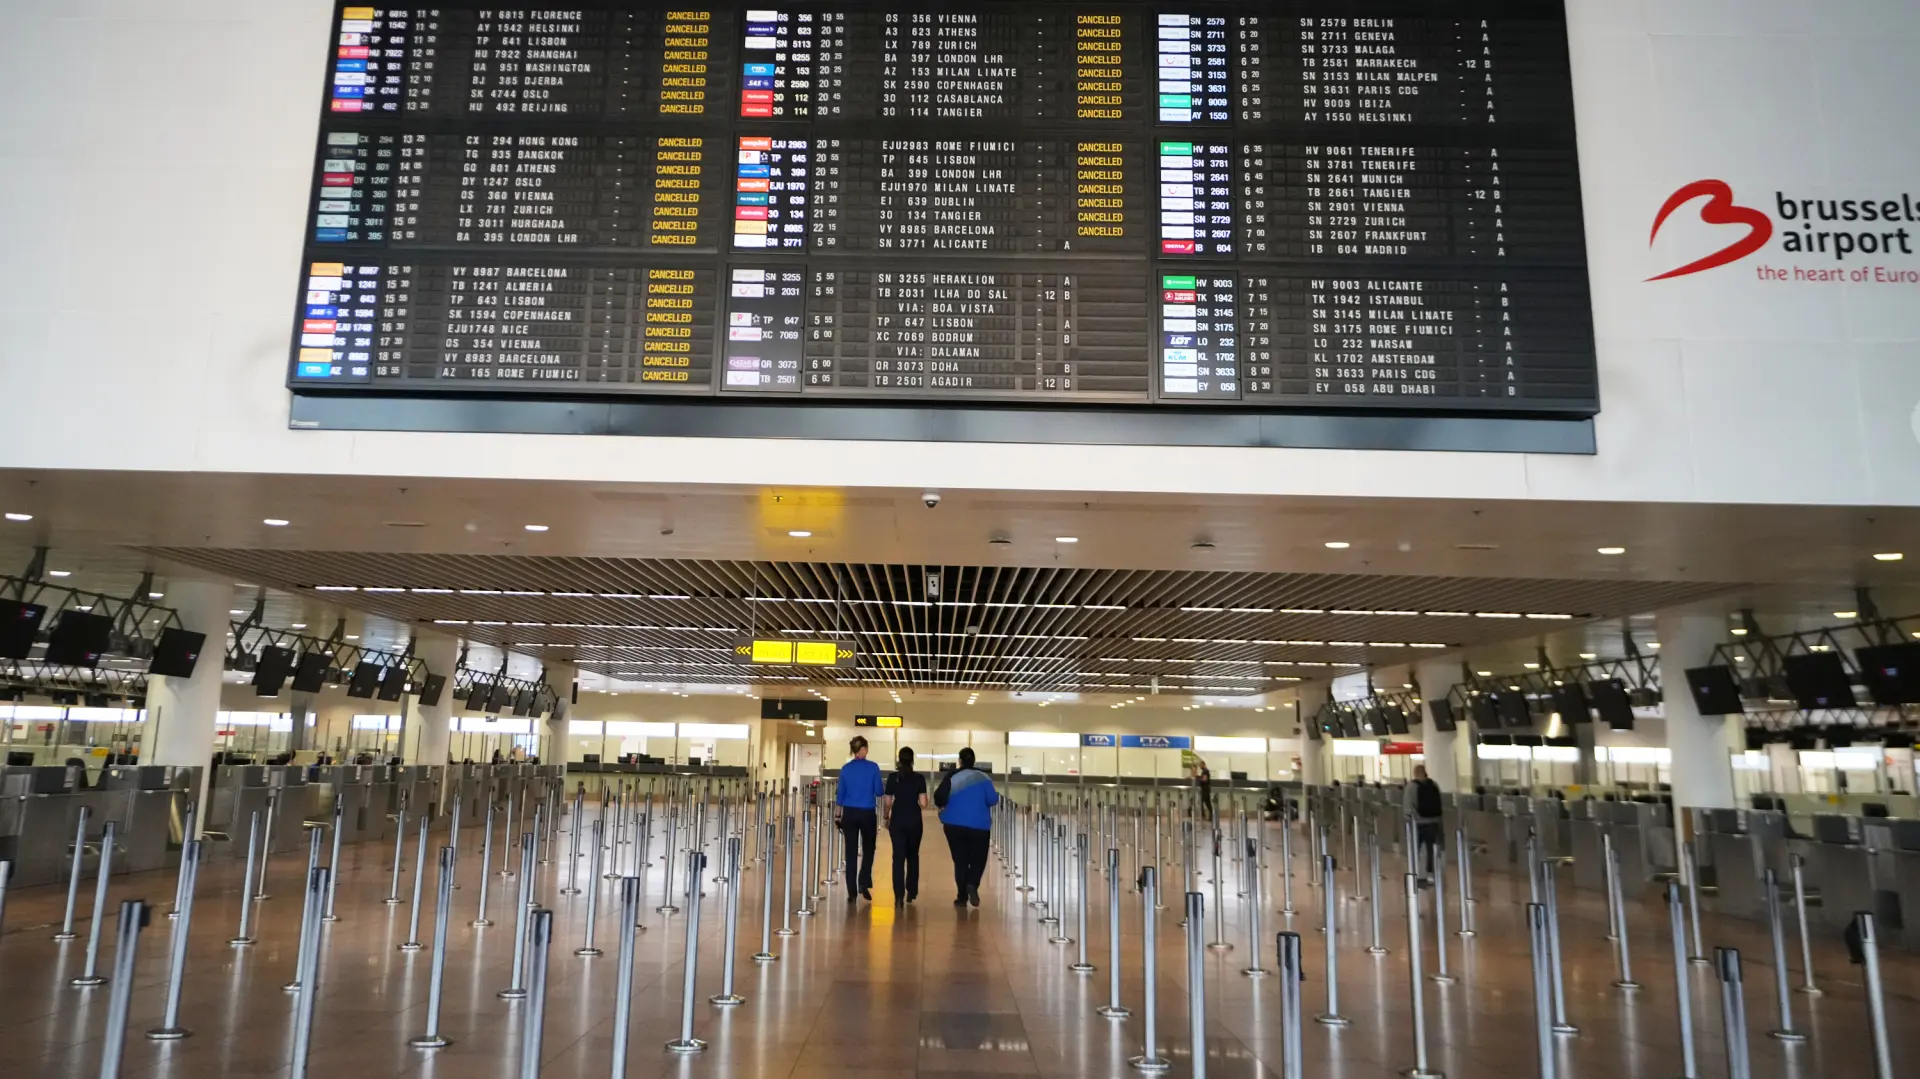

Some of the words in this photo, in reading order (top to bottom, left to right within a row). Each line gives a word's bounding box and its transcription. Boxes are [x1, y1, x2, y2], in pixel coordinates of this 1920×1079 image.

[479, 10, 492, 19] VY
[498, 10, 524, 19] 6815
[530, 10, 582, 20] FLORENCE
[666, 11, 710, 20] CANCELLED
[885, 13, 898, 23] OS
[912, 14, 930, 23] 356
[938, 14, 977, 23] VIENNA
[1077, 15, 1121, 24] CANCELLED
[1190, 17, 1201, 25] SN
[1206, 17, 1225, 26] 2579
[1239, 17, 1245, 26] 6
[1300, 17, 1313, 27] SN
[1320, 18, 1346, 27] 2579
[1353, 18, 1393, 28] BERLIN
[477, 23, 490, 31] AY
[497, 23, 522, 32] 1542
[528, 23, 579, 33] HELSINKI
[776, 26, 788, 35] A3
[797, 26, 812, 35] 623
[820, 26, 832, 35] 20
[474, 49, 488, 58] HU
[495, 49, 520, 59] 7922
[526, 49, 577, 59] SHANGHAI
[664, 50, 708, 60] CANCELLED
[884, 53, 897, 62] BA
[911, 53, 930, 62] 397
[937, 54, 976, 63] LONDON
[984, 54, 1002, 63] LHR
[1190, 57, 1201, 65] TB
[1207, 57, 1225, 66] 2581
[1302, 58, 1315, 67] TB
[1322, 58, 1348, 67] 2581
[1355, 58, 1416, 68] MARRAKECH
[884, 66, 896, 76] AZ
[911, 67, 929, 76] 153
[936, 67, 970, 76] MILAN
[977, 68, 1016, 76] LINATE
[1077, 68, 1122, 78] CANCELLED
[1303, 84, 1316, 94] SN
[1323, 85, 1349, 94] 3631
[1357, 85, 1390, 94] PARIS
[1398, 86, 1418, 95] CDG
[660, 90, 704, 100] CANCELLED
[466, 136, 479, 144] CX
[492, 136, 512, 145] 294
[518, 136, 545, 146] HONG
[551, 136, 578, 146] KONG
[658, 137, 702, 147] CANCELLED
[882, 140, 928, 150] EJU2983
[935, 141, 961, 150] ROME
[970, 141, 1014, 151] FIUMICI
[1077, 142, 1122, 152] CANCELLED
[1192, 145, 1204, 153] HV
[1209, 145, 1227, 154] 9061
[1243, 145, 1250, 154] 6
[1305, 146, 1319, 155] HV
[1326, 146, 1352, 155] 9061
[1360, 146, 1414, 156] TENERIFE
[881, 168, 894, 177] BA
[908, 168, 928, 178] 399
[935, 169, 975, 178] LONDON
[982, 169, 1002, 178] LHR
[460, 190, 474, 200] OS
[487, 190, 507, 200] 360
[514, 191, 554, 201] VIENNA
[654, 192, 699, 202] CANCELLED
[1307, 187, 1320, 197] TB
[1328, 187, 1354, 197] 2661
[1362, 188, 1410, 198] TANGIER
[1776, 192, 1920, 221] brussel
[879, 224, 892, 233] VY
[900, 224, 926, 234] 8985
[934, 225, 994, 235] BARCELONA
[1077, 226, 1123, 236] CANCELLED
[456, 232, 469, 241] BA
[483, 232, 503, 242] 395
[510, 232, 550, 242] LONDON
[557, 233, 577, 243] LHR
[765, 237, 778, 246] SN
[783, 238, 802, 247] 3771
[1783, 223, 1912, 260] airport
[453, 267, 466, 276] VY
[473, 267, 500, 277] 8987
[506, 267, 567, 277] BARCELONA
[649, 269, 694, 280] CANCELLED
[764, 272, 776, 281] SN
[782, 272, 801, 282] 3255
[1756, 265, 1788, 280] the
[1794, 266, 1845, 281] heart
[1850, 266, 1868, 282] of
[1874, 266, 1920, 282] Euro
[815, 273, 822, 282] 5
[1064, 277, 1070, 286] A
[1196, 278, 1207, 287] HV
[1213, 279, 1233, 288] 9003
[1311, 280, 1324, 289] HV
[1332, 280, 1359, 290] 9003
[1367, 280, 1422, 290] ALICANTE
[878, 288, 891, 297] TB
[898, 288, 924, 298] 2031
[934, 288, 960, 298] ILHA
[967, 289, 980, 299] DO
[988, 289, 1008, 299] SAL
[1045, 291, 1055, 300] 12
[1064, 291, 1071, 301] B
[1312, 294, 1325, 304] TK
[1333, 294, 1360, 304] 1942
[1369, 295, 1424, 305] ISTANBUL
[761, 330, 773, 339] XC
[779, 331, 799, 339] 7069
[813, 330, 819, 339] 6
[823, 330, 832, 338] 00
[876, 332, 889, 341] XC
[897, 332, 924, 341] 7069
[931, 332, 973, 342] BODRUM
[1197, 337, 1208, 346] LO
[1219, 337, 1234, 347] 232
[1197, 352, 1208, 361] KL
[1215, 352, 1234, 361] 1702
[1250, 352, 1256, 361] 8
[1260, 352, 1269, 360] 00
[1314, 352, 1328, 362] KL
[1336, 353, 1363, 363] 1702
[1371, 354, 1435, 364] AMSTERDAM
[875, 361, 888, 370] QR
[896, 361, 923, 371] 3073
[931, 361, 958, 371] DOHA
[1064, 364, 1070, 373] B
[442, 367, 456, 377] AZ
[471, 368, 490, 377] 165
[497, 368, 524, 378] ROME
[532, 368, 578, 379] FIUMICI
[642, 370, 688, 381] CANCELLED
[1316, 382, 1329, 392] EY
[1344, 383, 1365, 393] 058
[1372, 383, 1393, 394] ABU
[1400, 384, 1435, 394] DHABI
